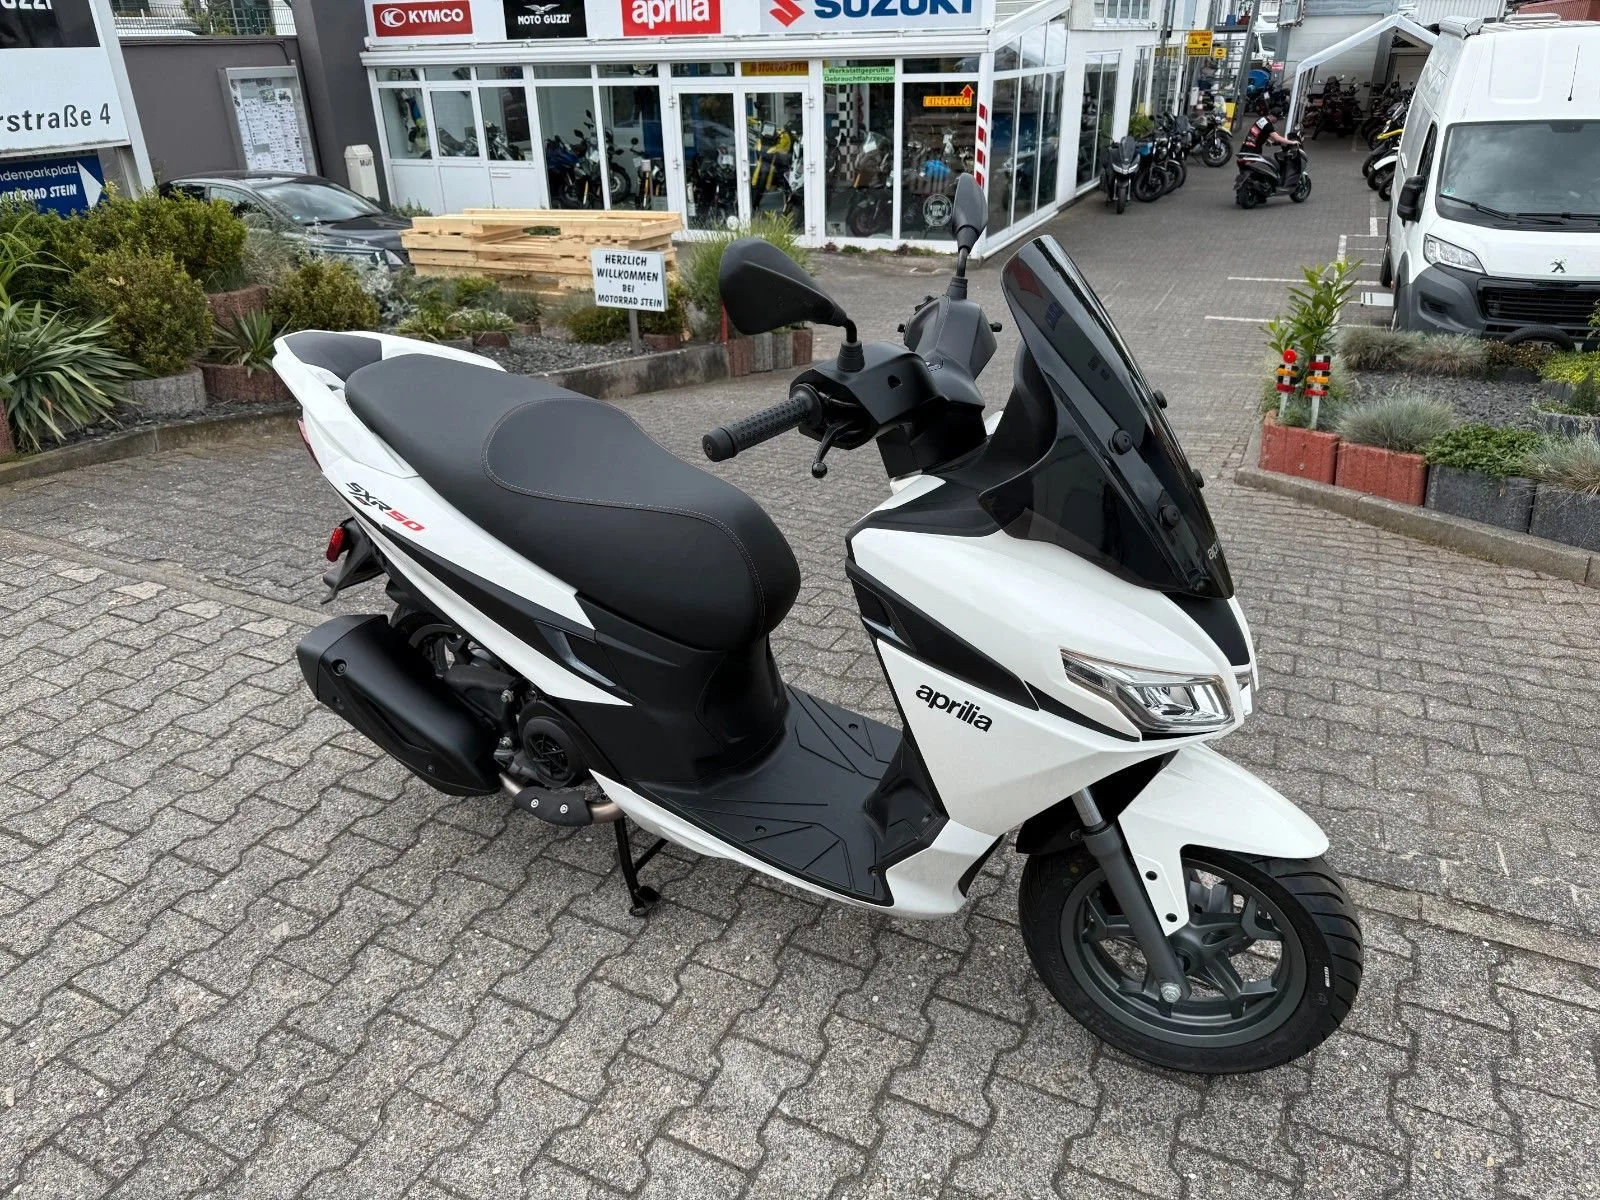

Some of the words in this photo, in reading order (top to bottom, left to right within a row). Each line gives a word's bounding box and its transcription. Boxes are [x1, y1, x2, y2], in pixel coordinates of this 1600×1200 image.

[408, 8, 464, 23] KYMCO
[631, 0, 710, 29] aprilia
[814, 0, 973, 19] SUZUKI
[518, 15, 541, 25] MOTO
[544, 14, 570, 24] GUZZI
[925, 96, 970, 106] EINGANG
[0, 105, 92, 132] straße
[100, 103, 111, 124] 4
[49, 184, 77, 198] STEIN
[605, 254, 647, 266] HERZLICH
[597, 268, 659, 282] WILLKOMMEN
[622, 284, 635, 293] BEI
[598, 294, 638, 305] MOTORRAD
[640, 298, 662, 307] STEIN
[915, 684, 993, 732] aprilia
